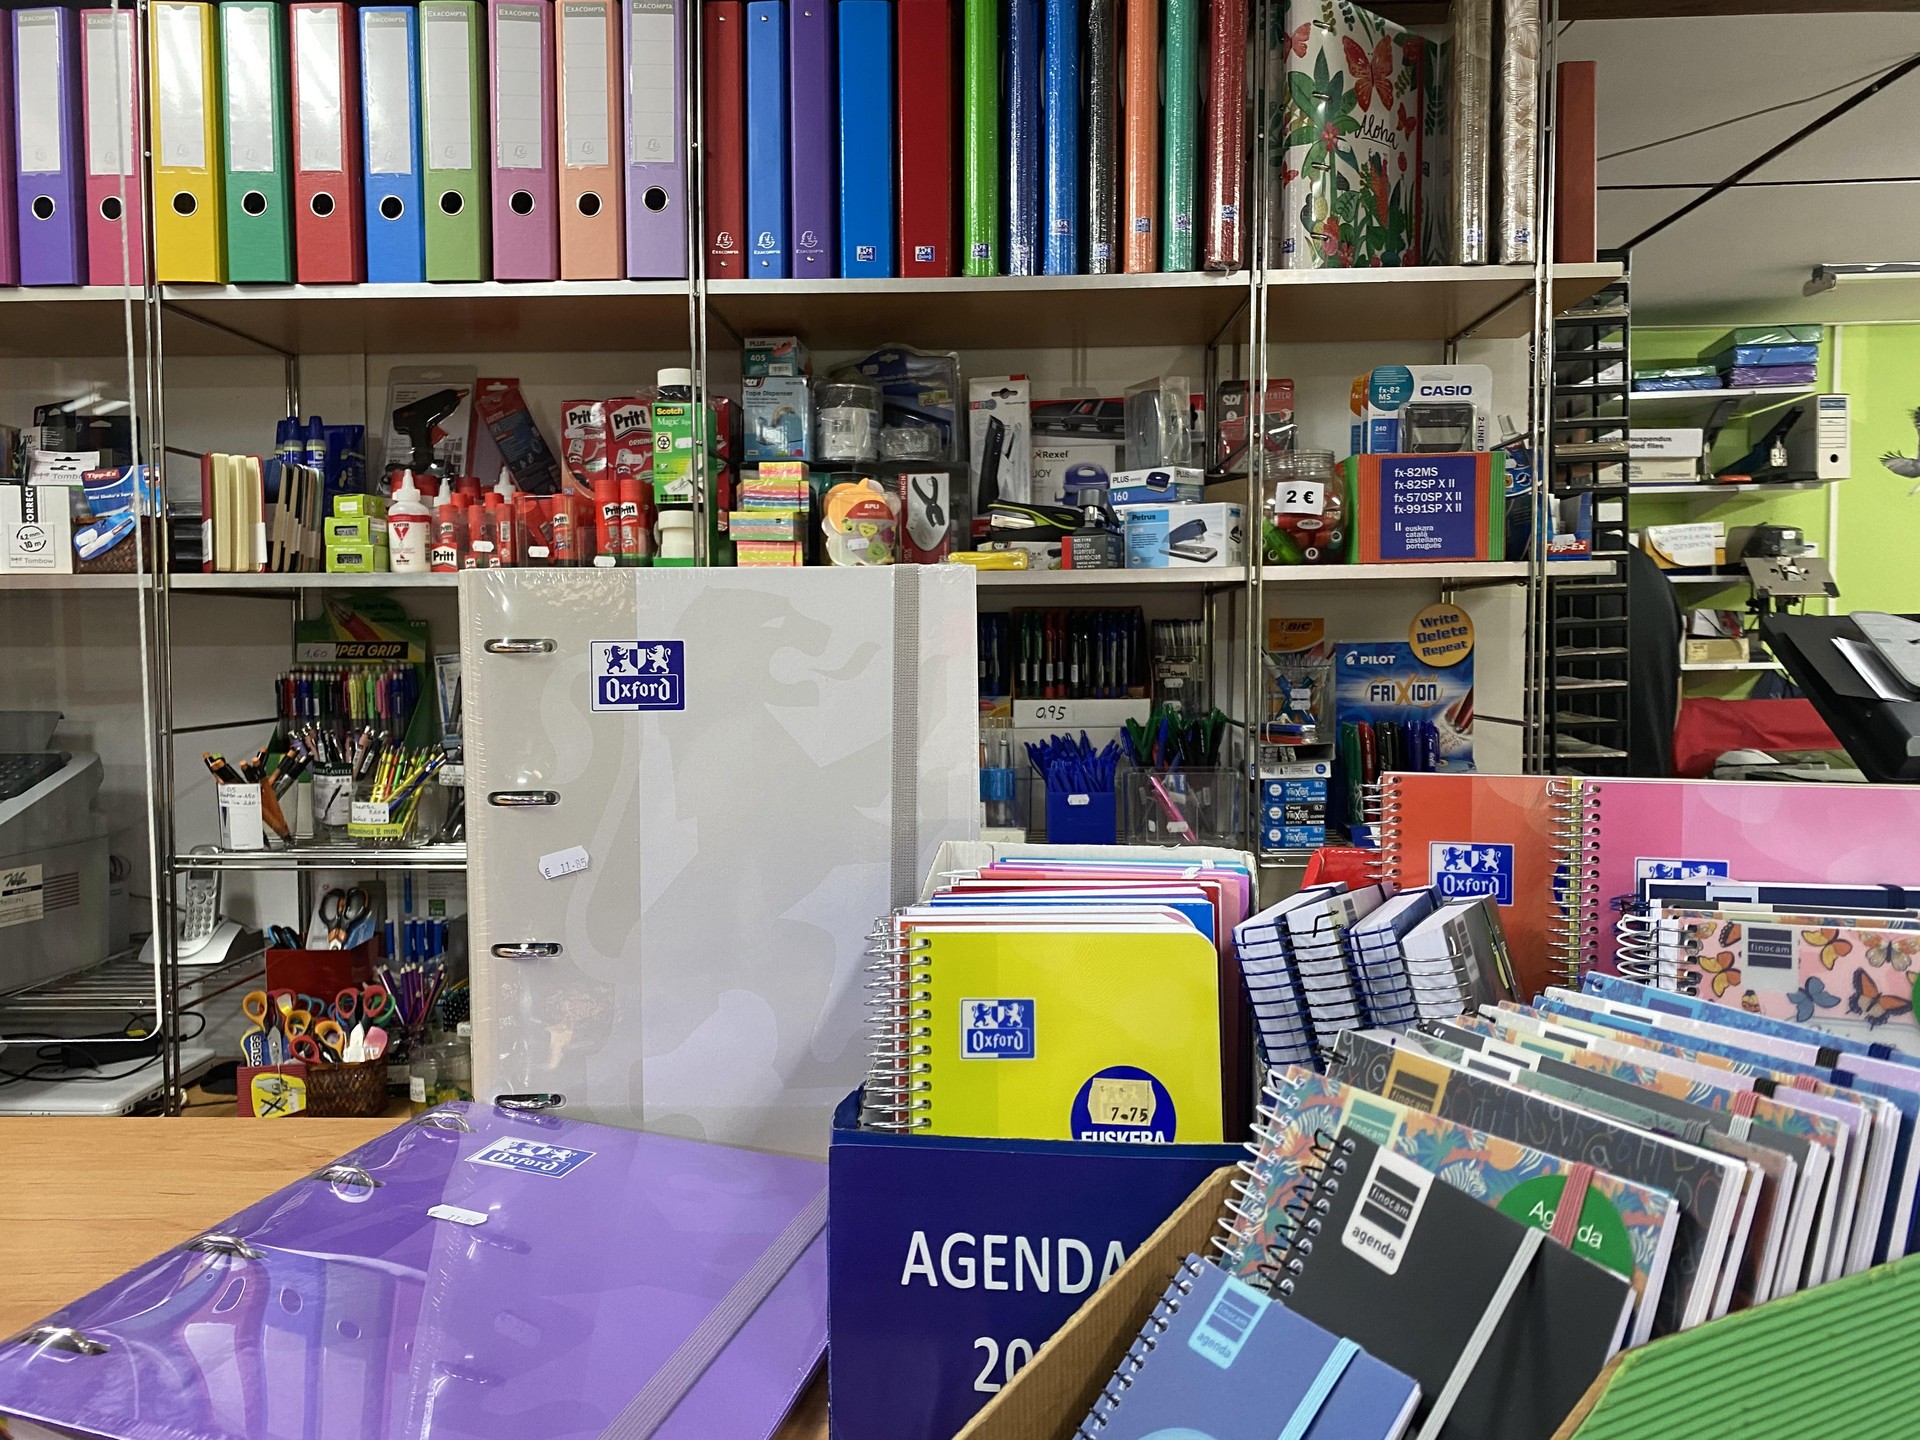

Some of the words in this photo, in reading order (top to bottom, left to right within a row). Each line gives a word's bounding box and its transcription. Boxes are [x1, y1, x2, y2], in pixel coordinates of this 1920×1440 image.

[633, 2, 673, 10] EXACOMPTA
[499, 9, 540, 17] EXACOMPTA
[1355, 114, 1399, 150] Aloha
[750, 354, 766, 362] 405
[762, 390, 793, 398] Dispenser
[1378, 386, 1400, 394] fx-82
[1420, 385, 1473, 396] CASIO
[569, 411, 592, 426] Prit
[613, 409, 646, 430] Pritt
[657, 418, 679, 427] Magic
[1042, 450, 1070, 459] Rexel
[1032, 468, 1052, 478] JOY
[1176, 470, 1190, 478] PLUS
[1394, 467, 1438, 478] fx-82MS
[1112, 474, 1130, 484] PLUS
[1394, 480, 1436, 490] fx-82SP
[1438, 479, 1446, 488] X
[1113, 491, 1128, 502] 160
[1286, 490, 1296, 504] 2
[1303, 490, 1314, 504] €
[1394, 492, 1442, 503] fx-570SP
[1445, 492, 1453, 501] X
[1394, 504, 1442, 514] fx-991SP
[1445, 504, 1453, 512] X
[433, 550, 454, 562] Pritt
[1287, 622, 1312, 631] BIC
[1420, 613, 1459, 628] Write
[1416, 626, 1468, 644] Delete
[336, 645, 366, 656] PER
[367, 644, 402, 656] GRIP
[1422, 640, 1468, 656] Repeat
[1360, 656, 1396, 664] PILOT
[606, 678, 670, 702] Oxford
[1442, 874, 1500, 896] Oxford
[1750, 942, 1790, 954] finocam
[972, 1030, 1024, 1050] Oxford
[1391, 1088, 1430, 1112] finocam
[1111, 1107, 1148, 1122] 7.75
[488, 1152, 560, 1171] Oxford
[1370, 1186, 1410, 1219] finocam
[1529, 1200, 1603, 1250] Agda
[1352, 1225, 1397, 1261] agenda
[901, 1230, 1132, 1294] AGENDA
[1197, 1333, 1232, 1358] agenda
[973, 1336, 1040, 1394] 20
